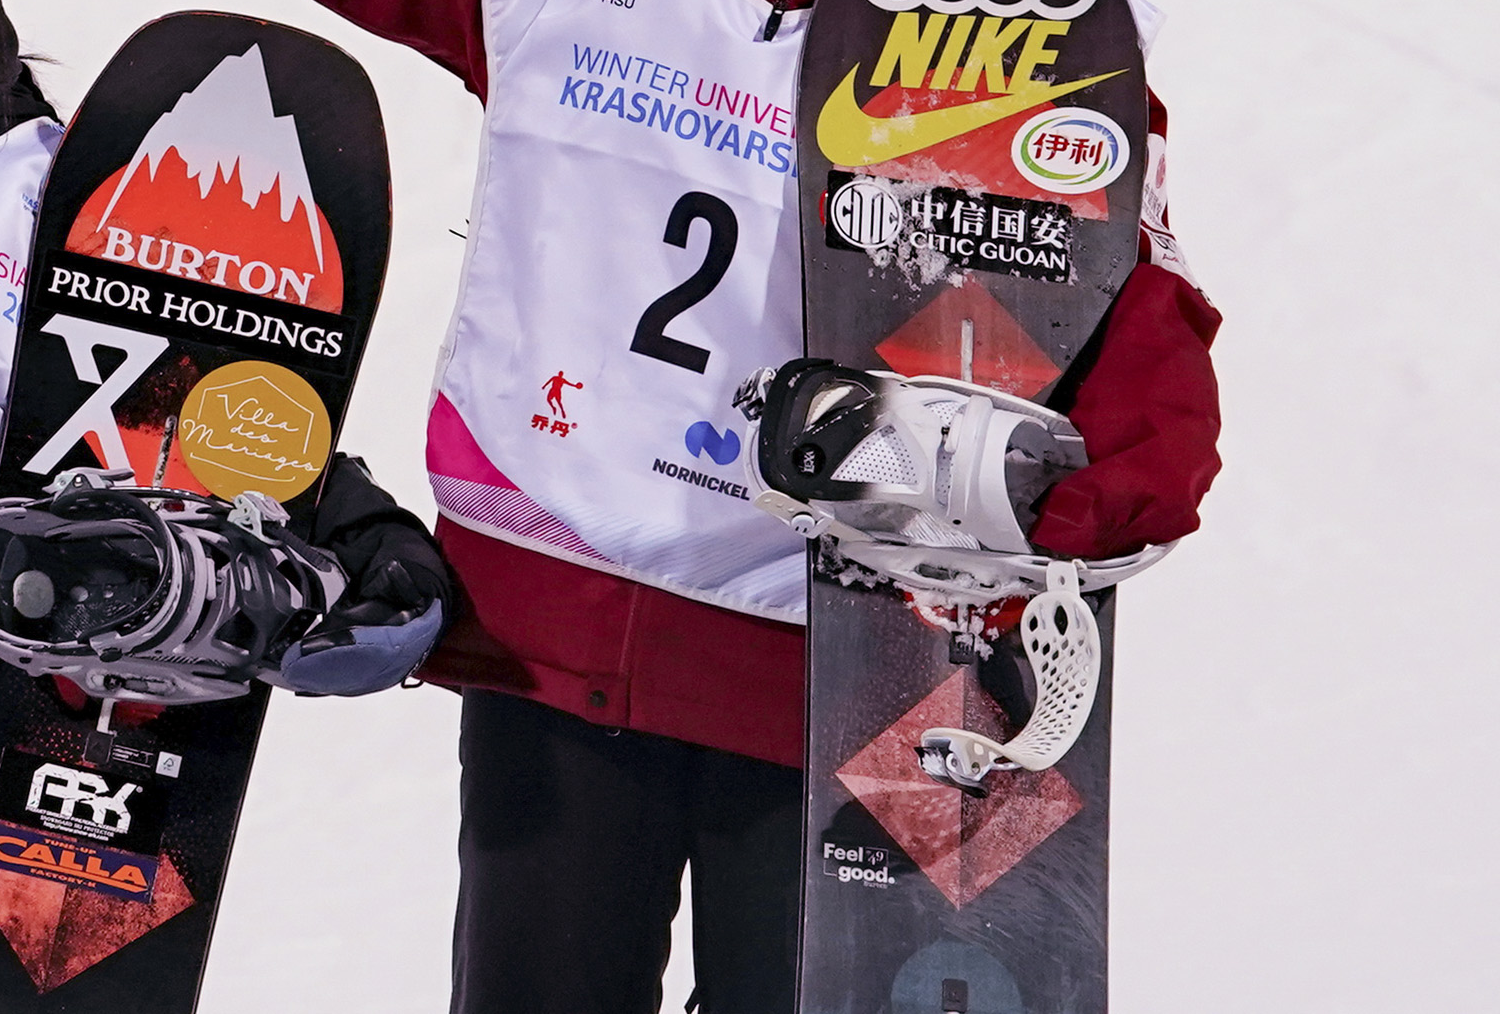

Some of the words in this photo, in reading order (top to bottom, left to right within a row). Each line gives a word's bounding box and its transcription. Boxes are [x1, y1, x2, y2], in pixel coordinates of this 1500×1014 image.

[869, 12, 1073, 95] NIKE
[573, 43, 689, 98] WINTER
[695, 78, 796, 139] UNIVE
[559, 76, 797, 178] KRASNOYARS
[1033, 132, 1104, 167] 伊利
[911, 195, 1067, 249] 中信国安
[101, 226, 315, 305] BURTON
[910, 231, 975, 257] CITIC
[979, 240, 1067, 271] GUOAN
[629, 191, 739, 375] 2
[3, 291, 21, 324] 2
[47, 267, 152, 314] PRIOR
[160, 292, 344, 358] HOLDINGS
[217, 394, 299, 432] Villa
[230, 423, 278, 443] des
[531, 413, 569, 438] 乔丹
[182, 419, 320, 472] Mariages
[652, 458, 751, 502] NORNICKEL
[43, 838, 97, 855] TUNE-UP
[823, 842, 863, 863] Feel
[838, 866, 895, 885] good.
